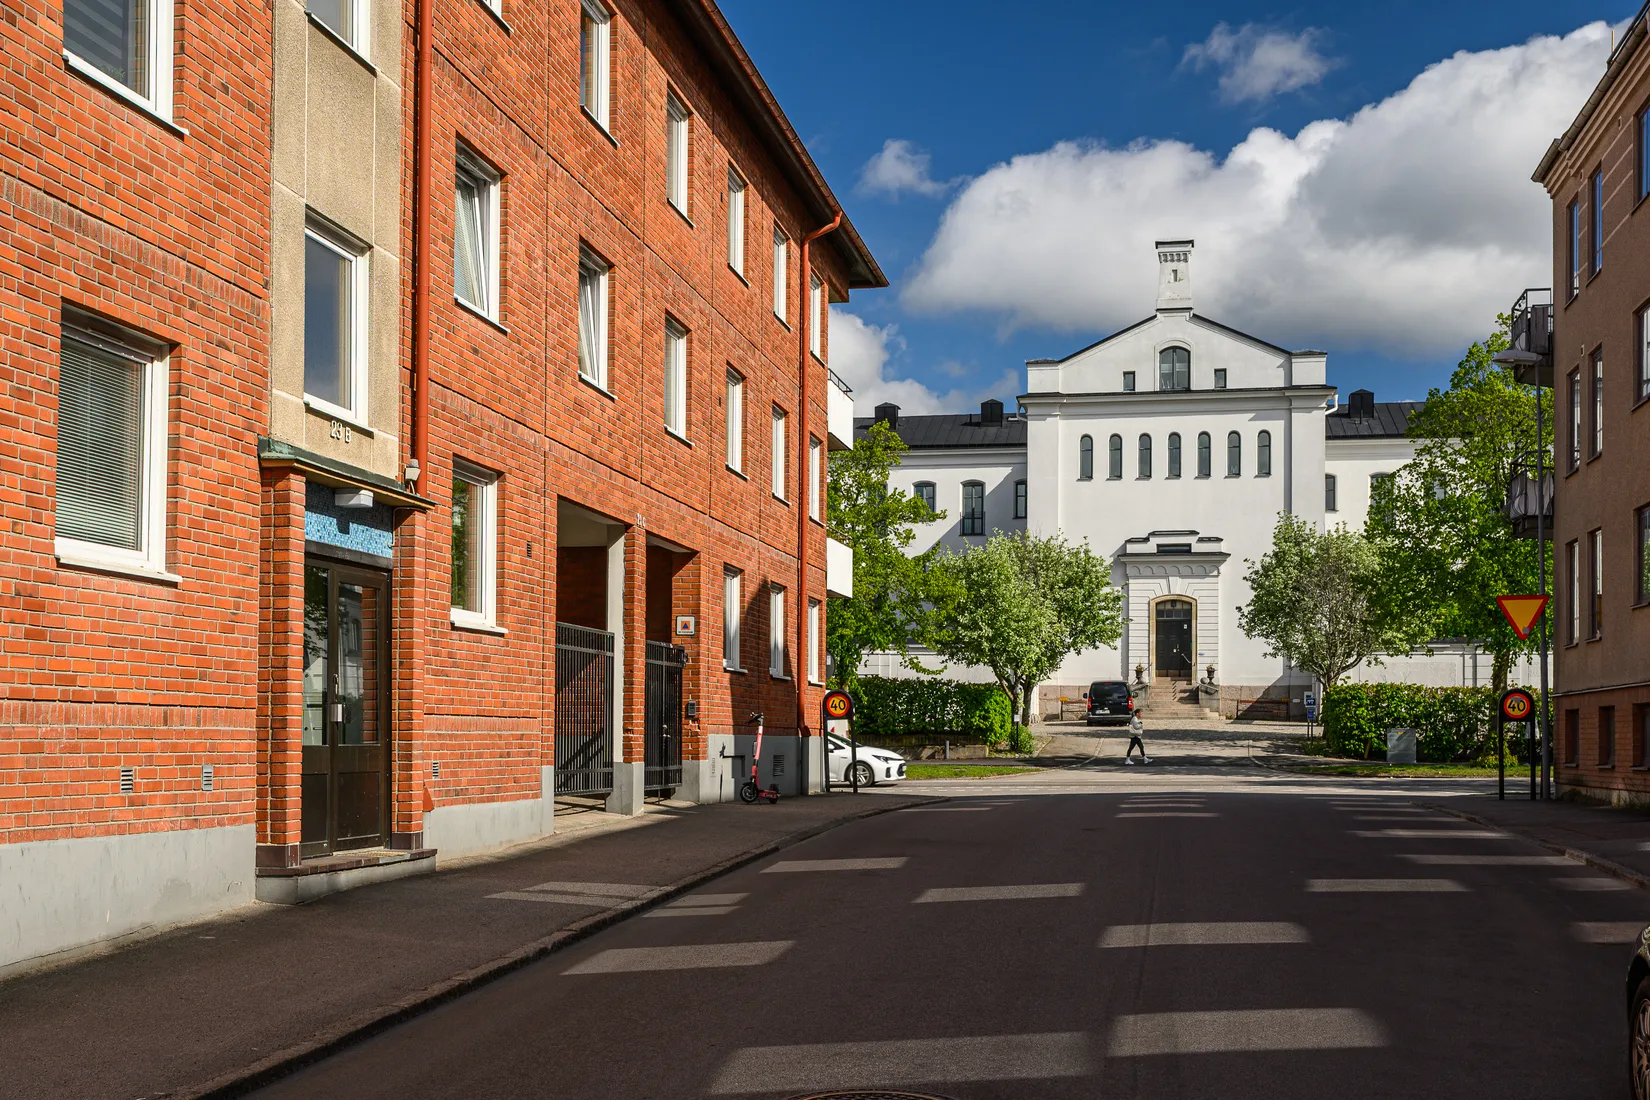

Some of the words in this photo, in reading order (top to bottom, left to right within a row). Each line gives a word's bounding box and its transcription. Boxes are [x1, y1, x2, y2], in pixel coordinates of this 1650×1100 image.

[331, 420, 343, 439] 23
[345, 427, 352, 443] B
[830, 699, 846, 711] 40
[1507, 699, 1526, 712] 40
